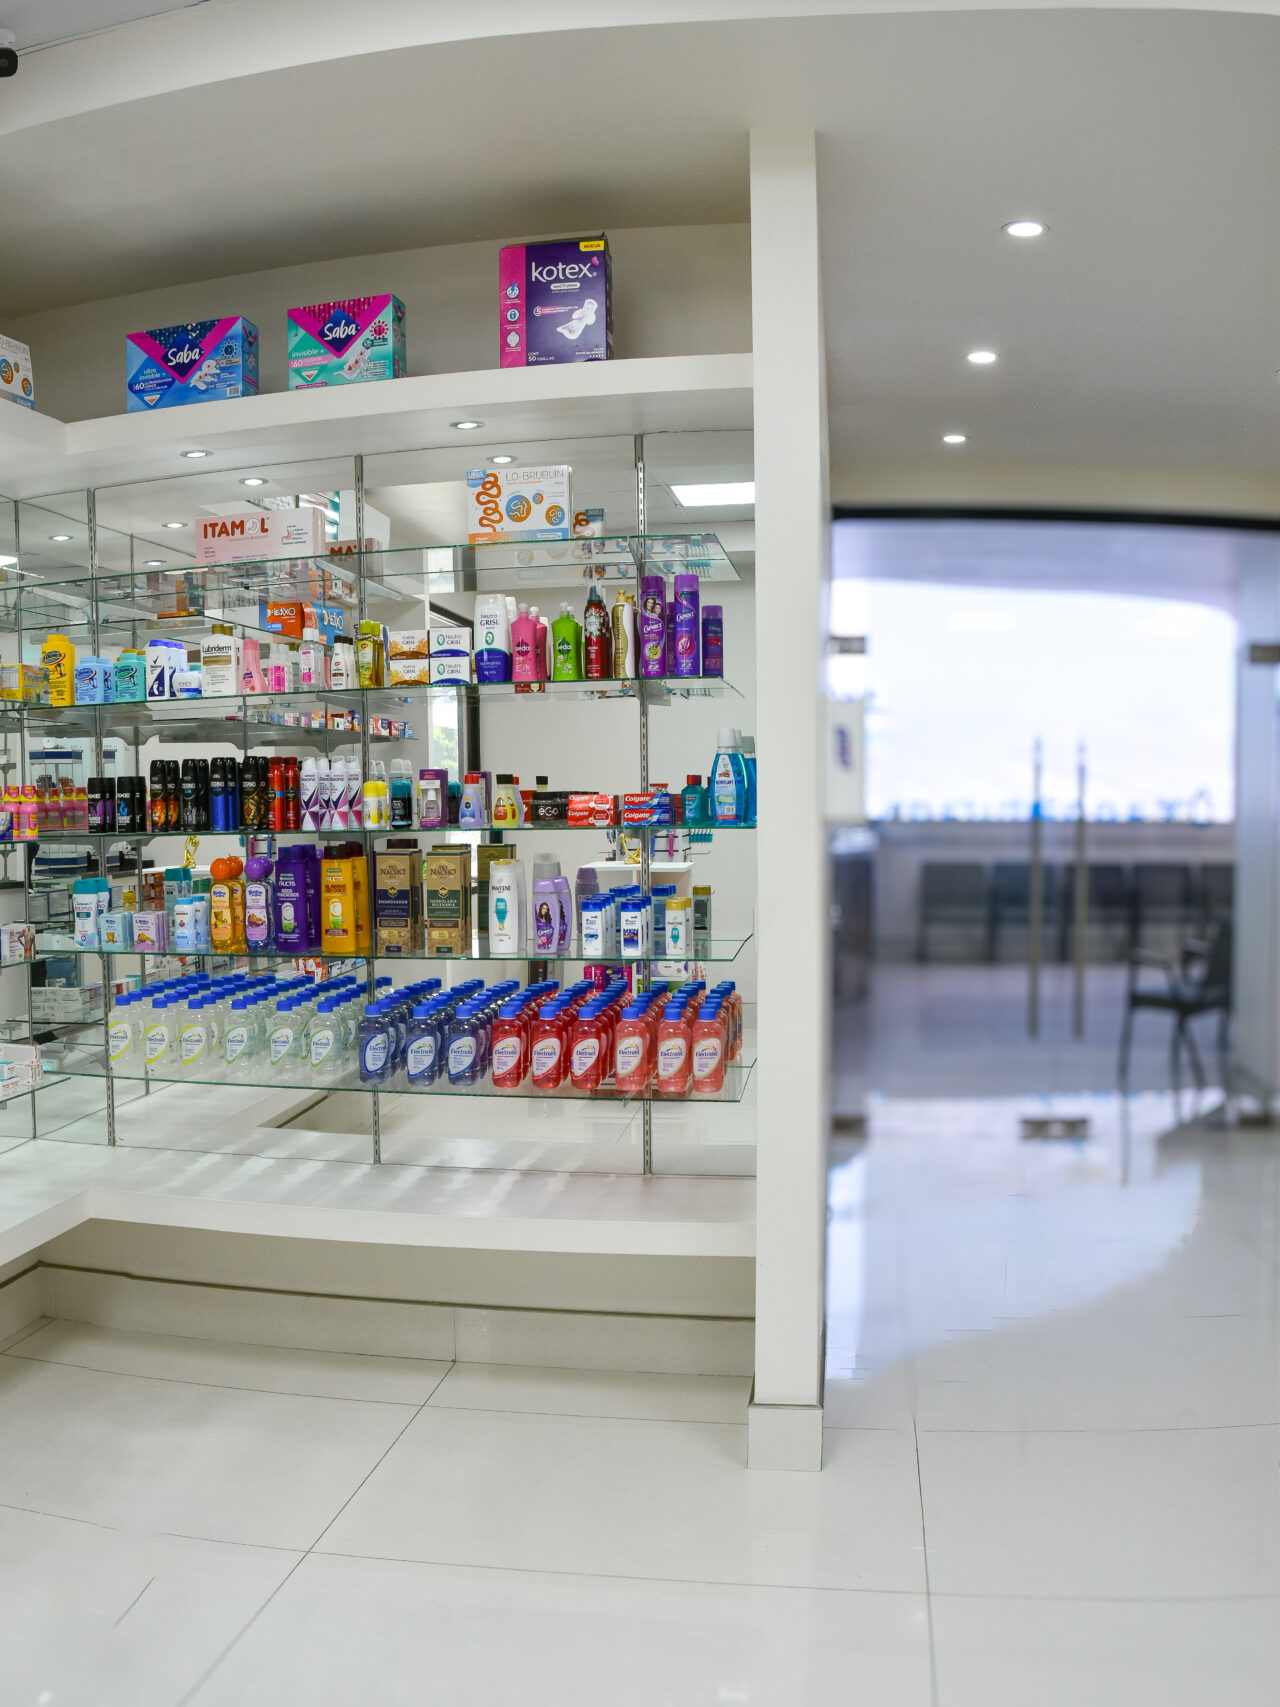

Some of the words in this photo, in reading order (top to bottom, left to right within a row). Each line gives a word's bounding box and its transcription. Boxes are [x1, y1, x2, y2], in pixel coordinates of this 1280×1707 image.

[531, 261, 593, 282] kotex
[323, 319, 357, 341] Saba
[167, 343, 200, 366] Saba
[202, 645, 232, 653] Lubriderm
[624, 795, 651, 803] Colgate
[380, 868, 406, 876] NACHO
[430, 868, 457, 876] NACHO
